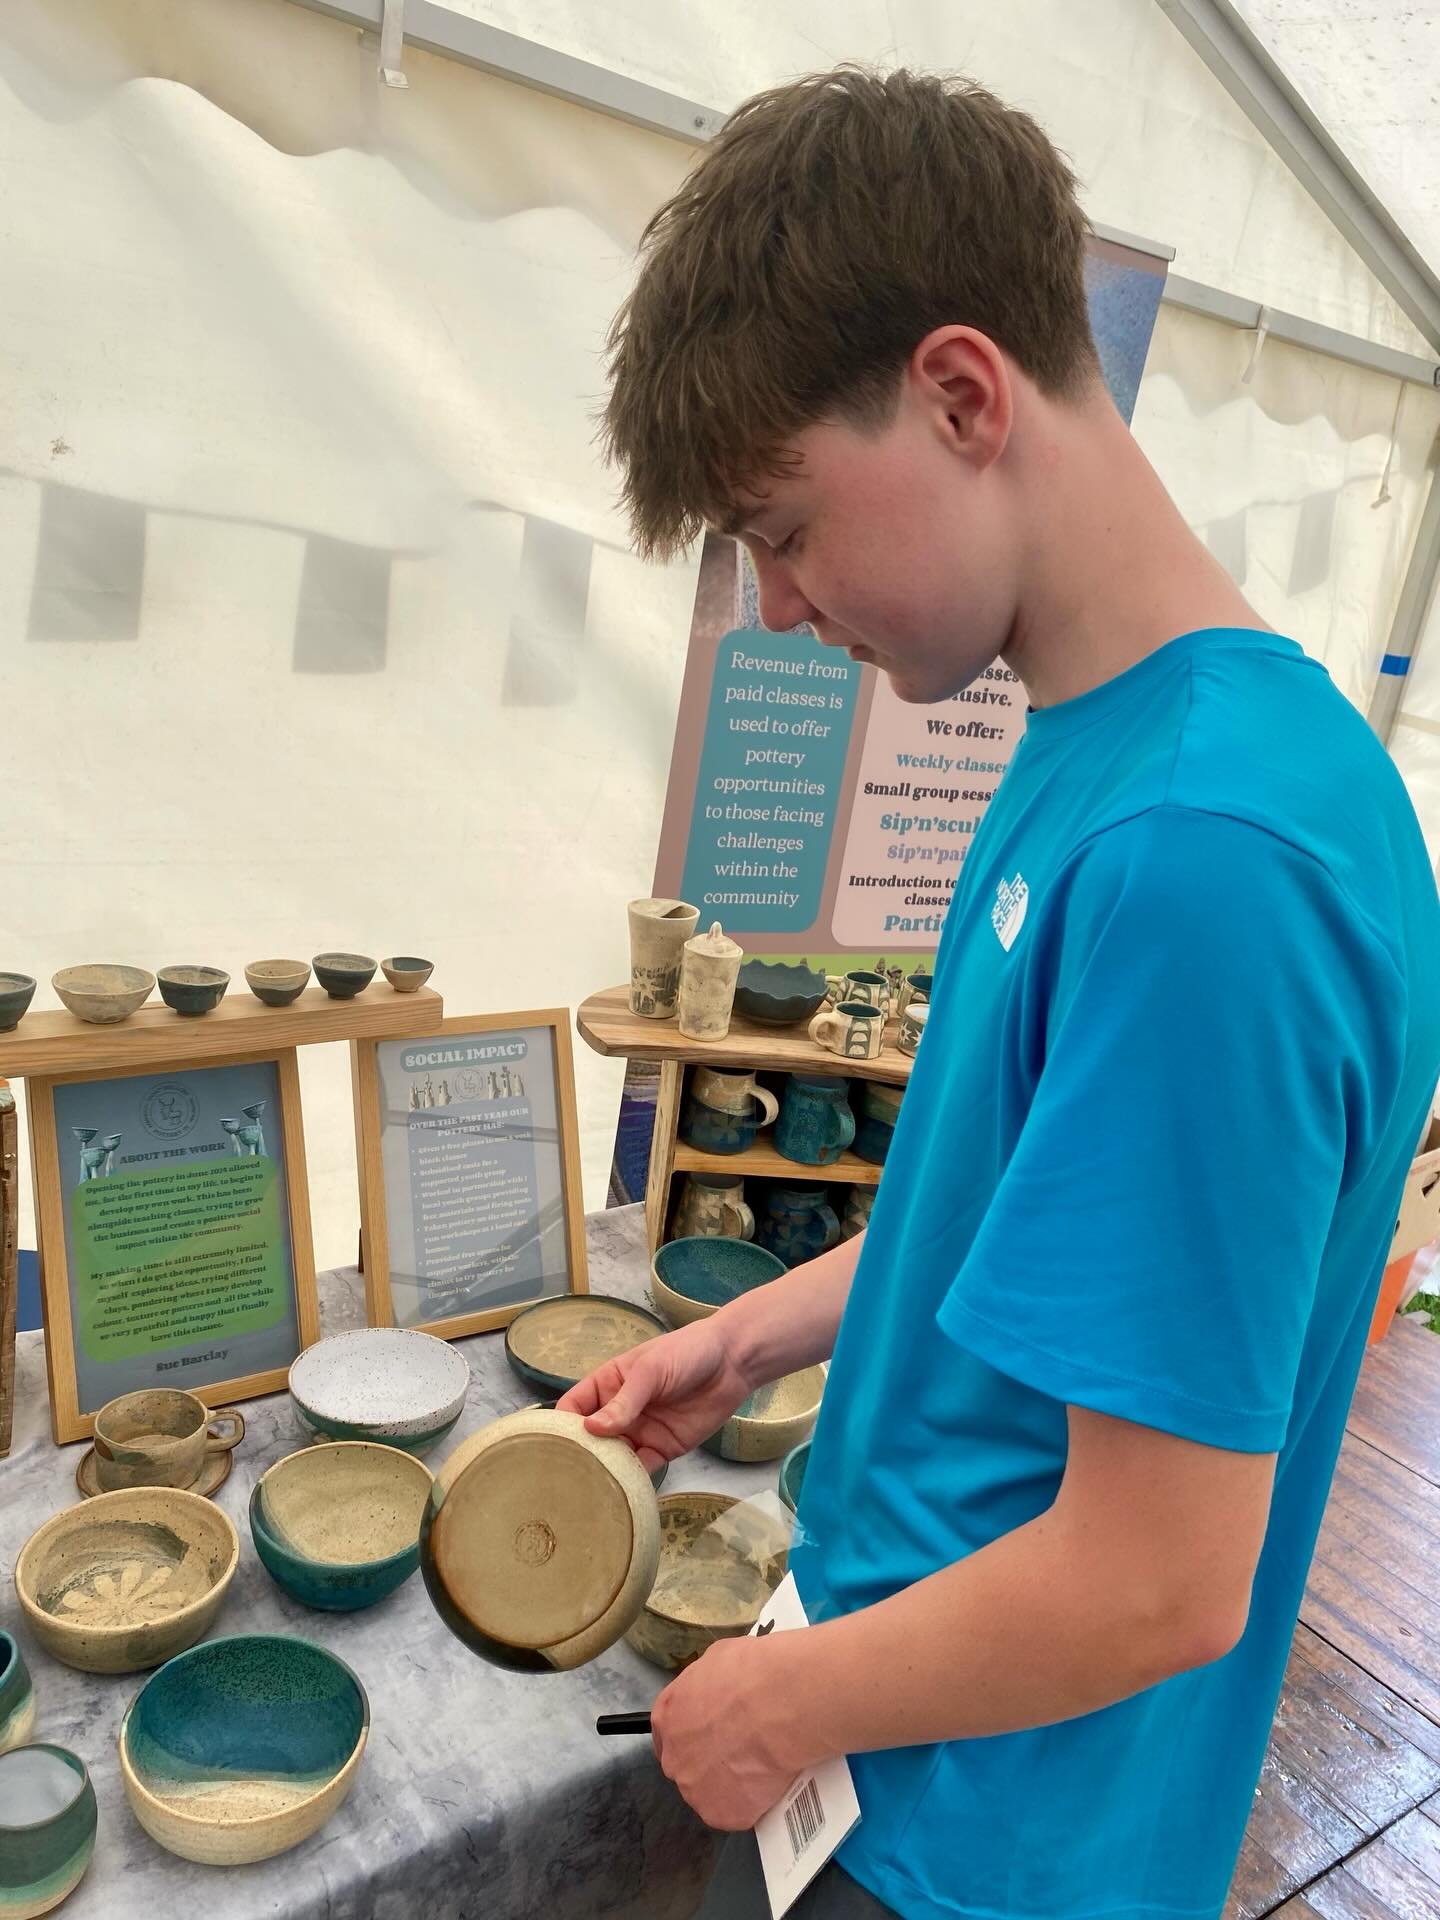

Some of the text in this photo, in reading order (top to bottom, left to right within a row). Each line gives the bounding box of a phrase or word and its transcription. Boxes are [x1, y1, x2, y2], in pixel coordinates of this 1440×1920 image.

[731, 651, 848, 680] Revenue from
[725, 685, 843, 709] paid classes is
[730, 716, 831, 737] used to offer
[927, 719, 1004, 740] We offer:
[745, 750, 805, 768] pottery
[897, 753, 953, 774] Weekly
[714, 777, 825, 795] opportunities
[864, 782, 910, 797] Small
[913, 787, 959, 802] group
[705, 803, 824, 827] to those facing
[717, 832, 804, 853] challenges
[715, 861, 798, 877] within the
[849, 875, 941, 889] Introduction
[704, 890, 799, 907] community
[905, 893, 951, 905] classes
[404, 1043, 525, 1066] SOCIAL IMPACT
[409, 1120, 435, 1129] OVER
[437, 1117, 457, 1125] THE
[483, 1110, 507, 1119] YEAR
[509, 1107, 528, 1116] OUR
[437, 1124, 480, 1136] POTTERY
[119, 1142, 225, 1164] ABOUT THE WORK
[85, 1182, 125, 1195] Opening
[142, 1175, 174, 1186] pottery
[134, 1189, 153, 1198] first
[99, 1205, 133, 1217] develop
[155, 1348, 228, 1371] Sue Barclay
